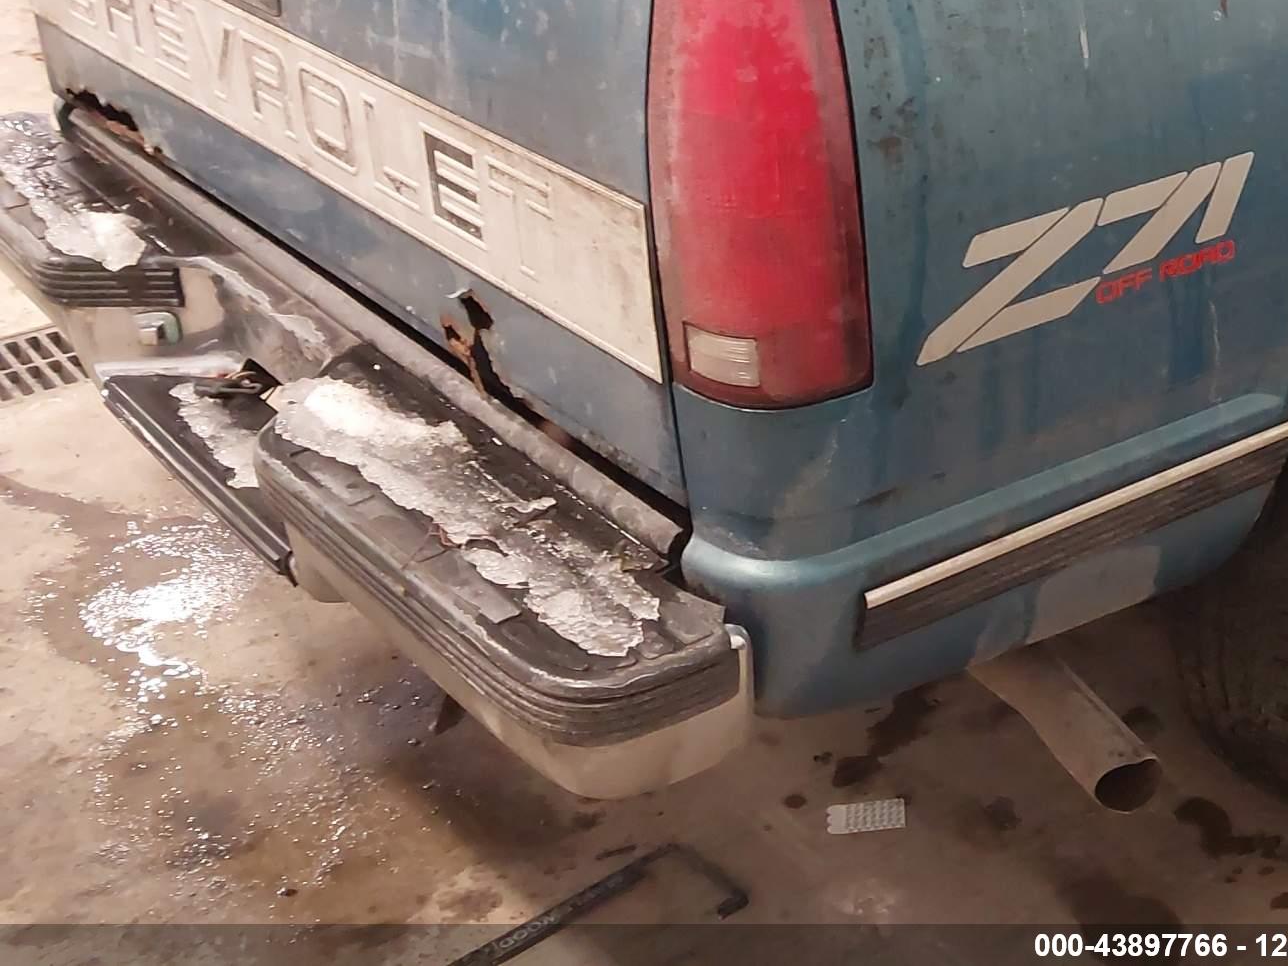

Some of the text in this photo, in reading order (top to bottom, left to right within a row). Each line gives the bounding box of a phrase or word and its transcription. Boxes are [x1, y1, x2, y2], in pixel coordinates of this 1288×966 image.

[916, 151, 1255, 366] Z71
[1095, 239, 1236, 304] OFF ROAD
